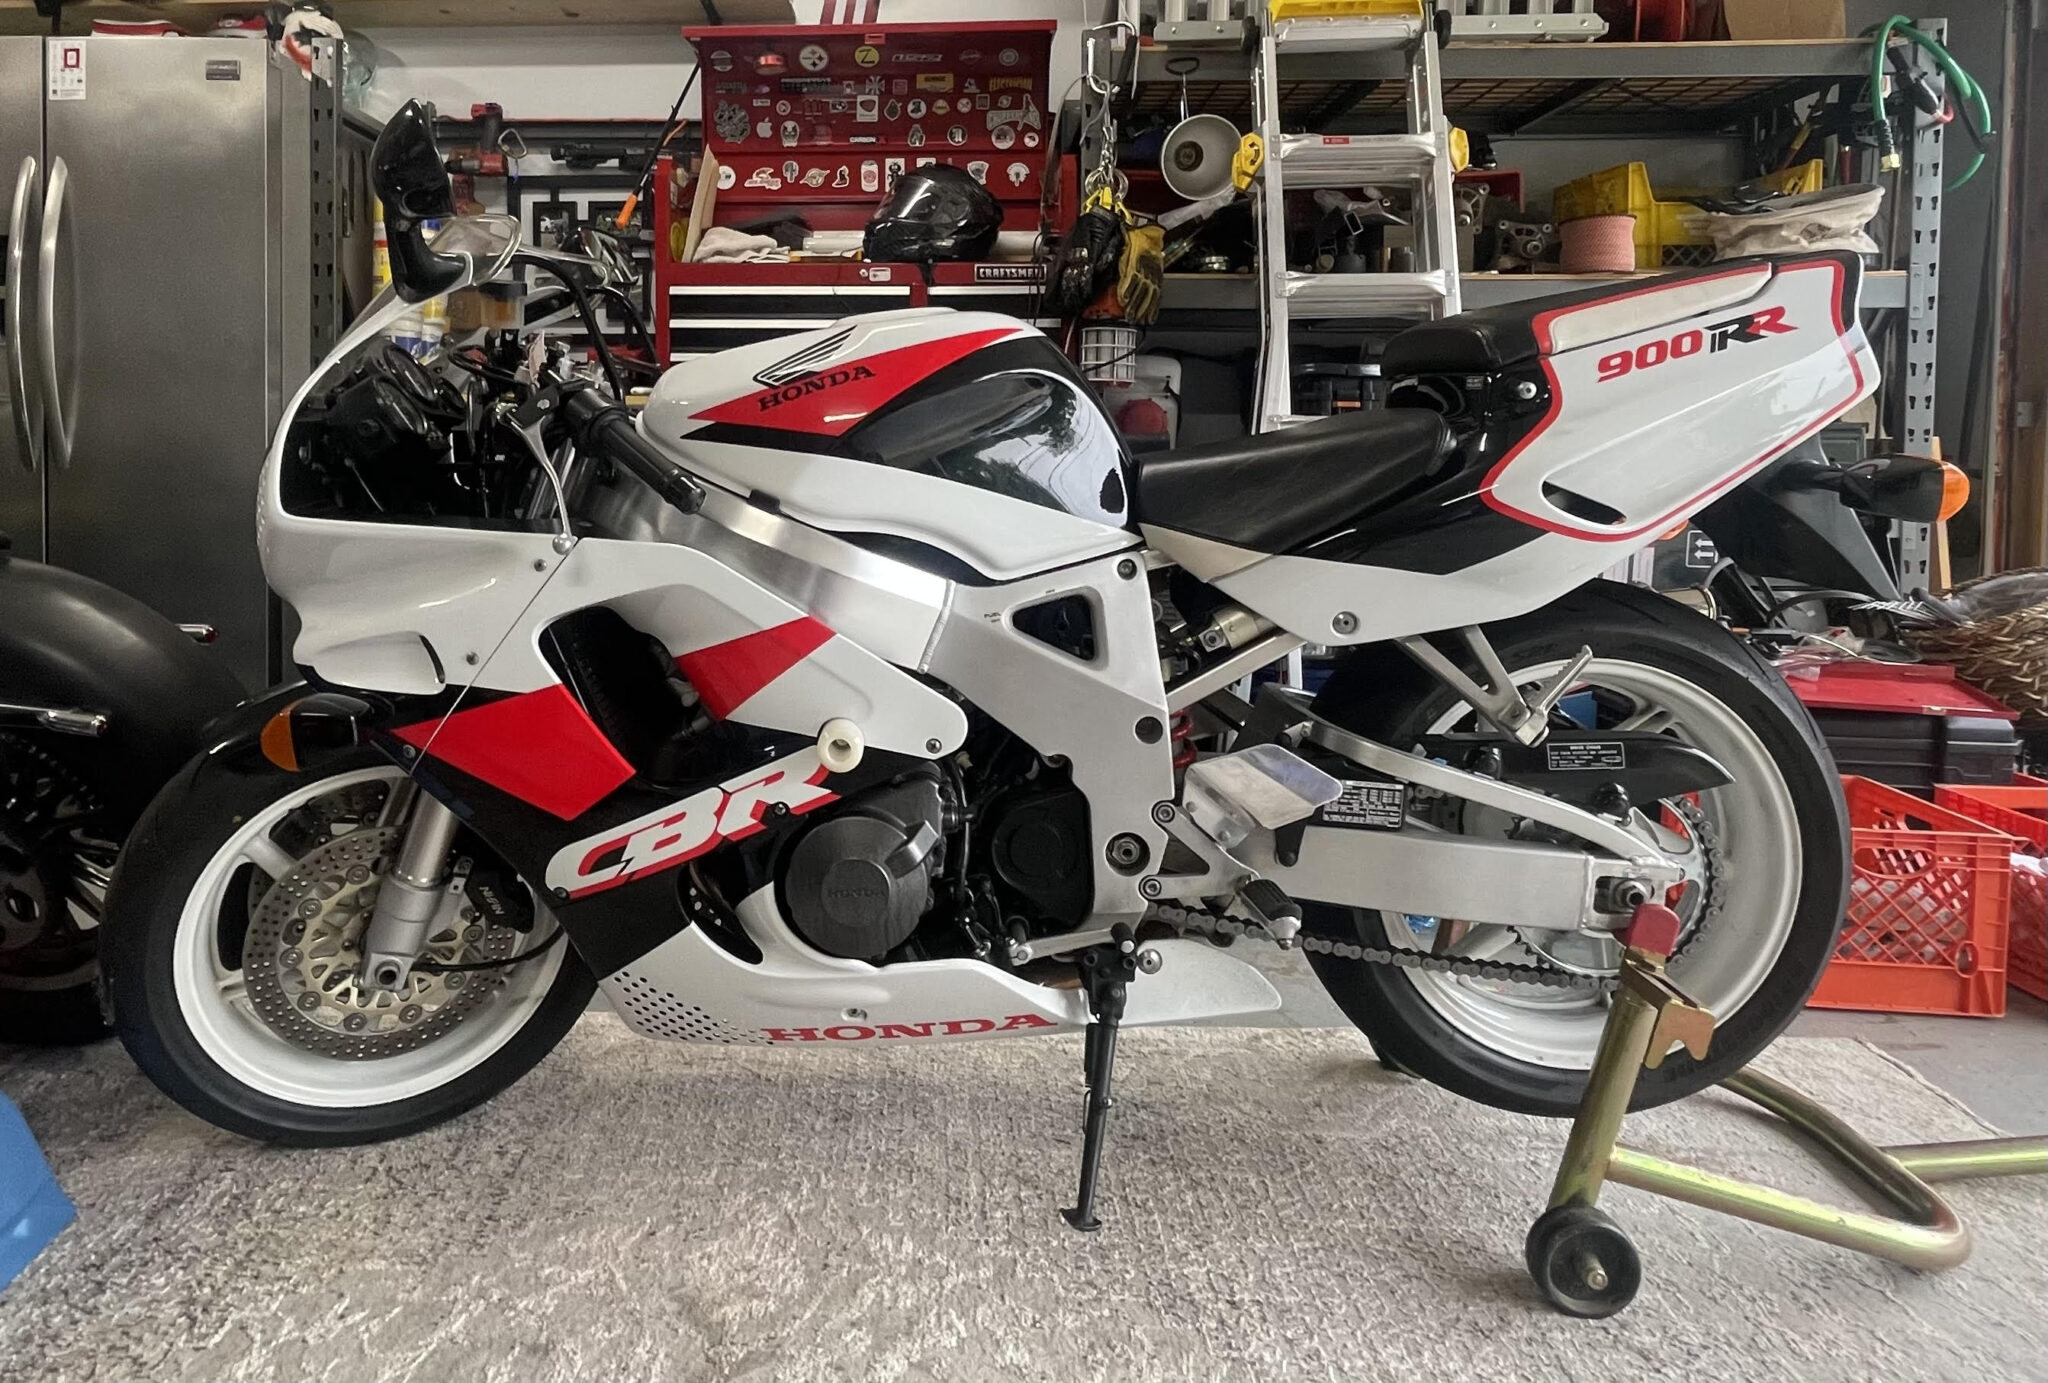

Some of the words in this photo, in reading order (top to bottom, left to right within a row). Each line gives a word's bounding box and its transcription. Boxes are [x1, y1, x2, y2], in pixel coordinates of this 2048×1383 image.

[979, 268, 1043, 278] CRAFTSMAN
[758, 366, 876, 411] HONDA
[545, 745, 842, 899] CBR
[827, 888, 888, 898] HONDA
[760, 1013, 1058, 1042] HONDA
